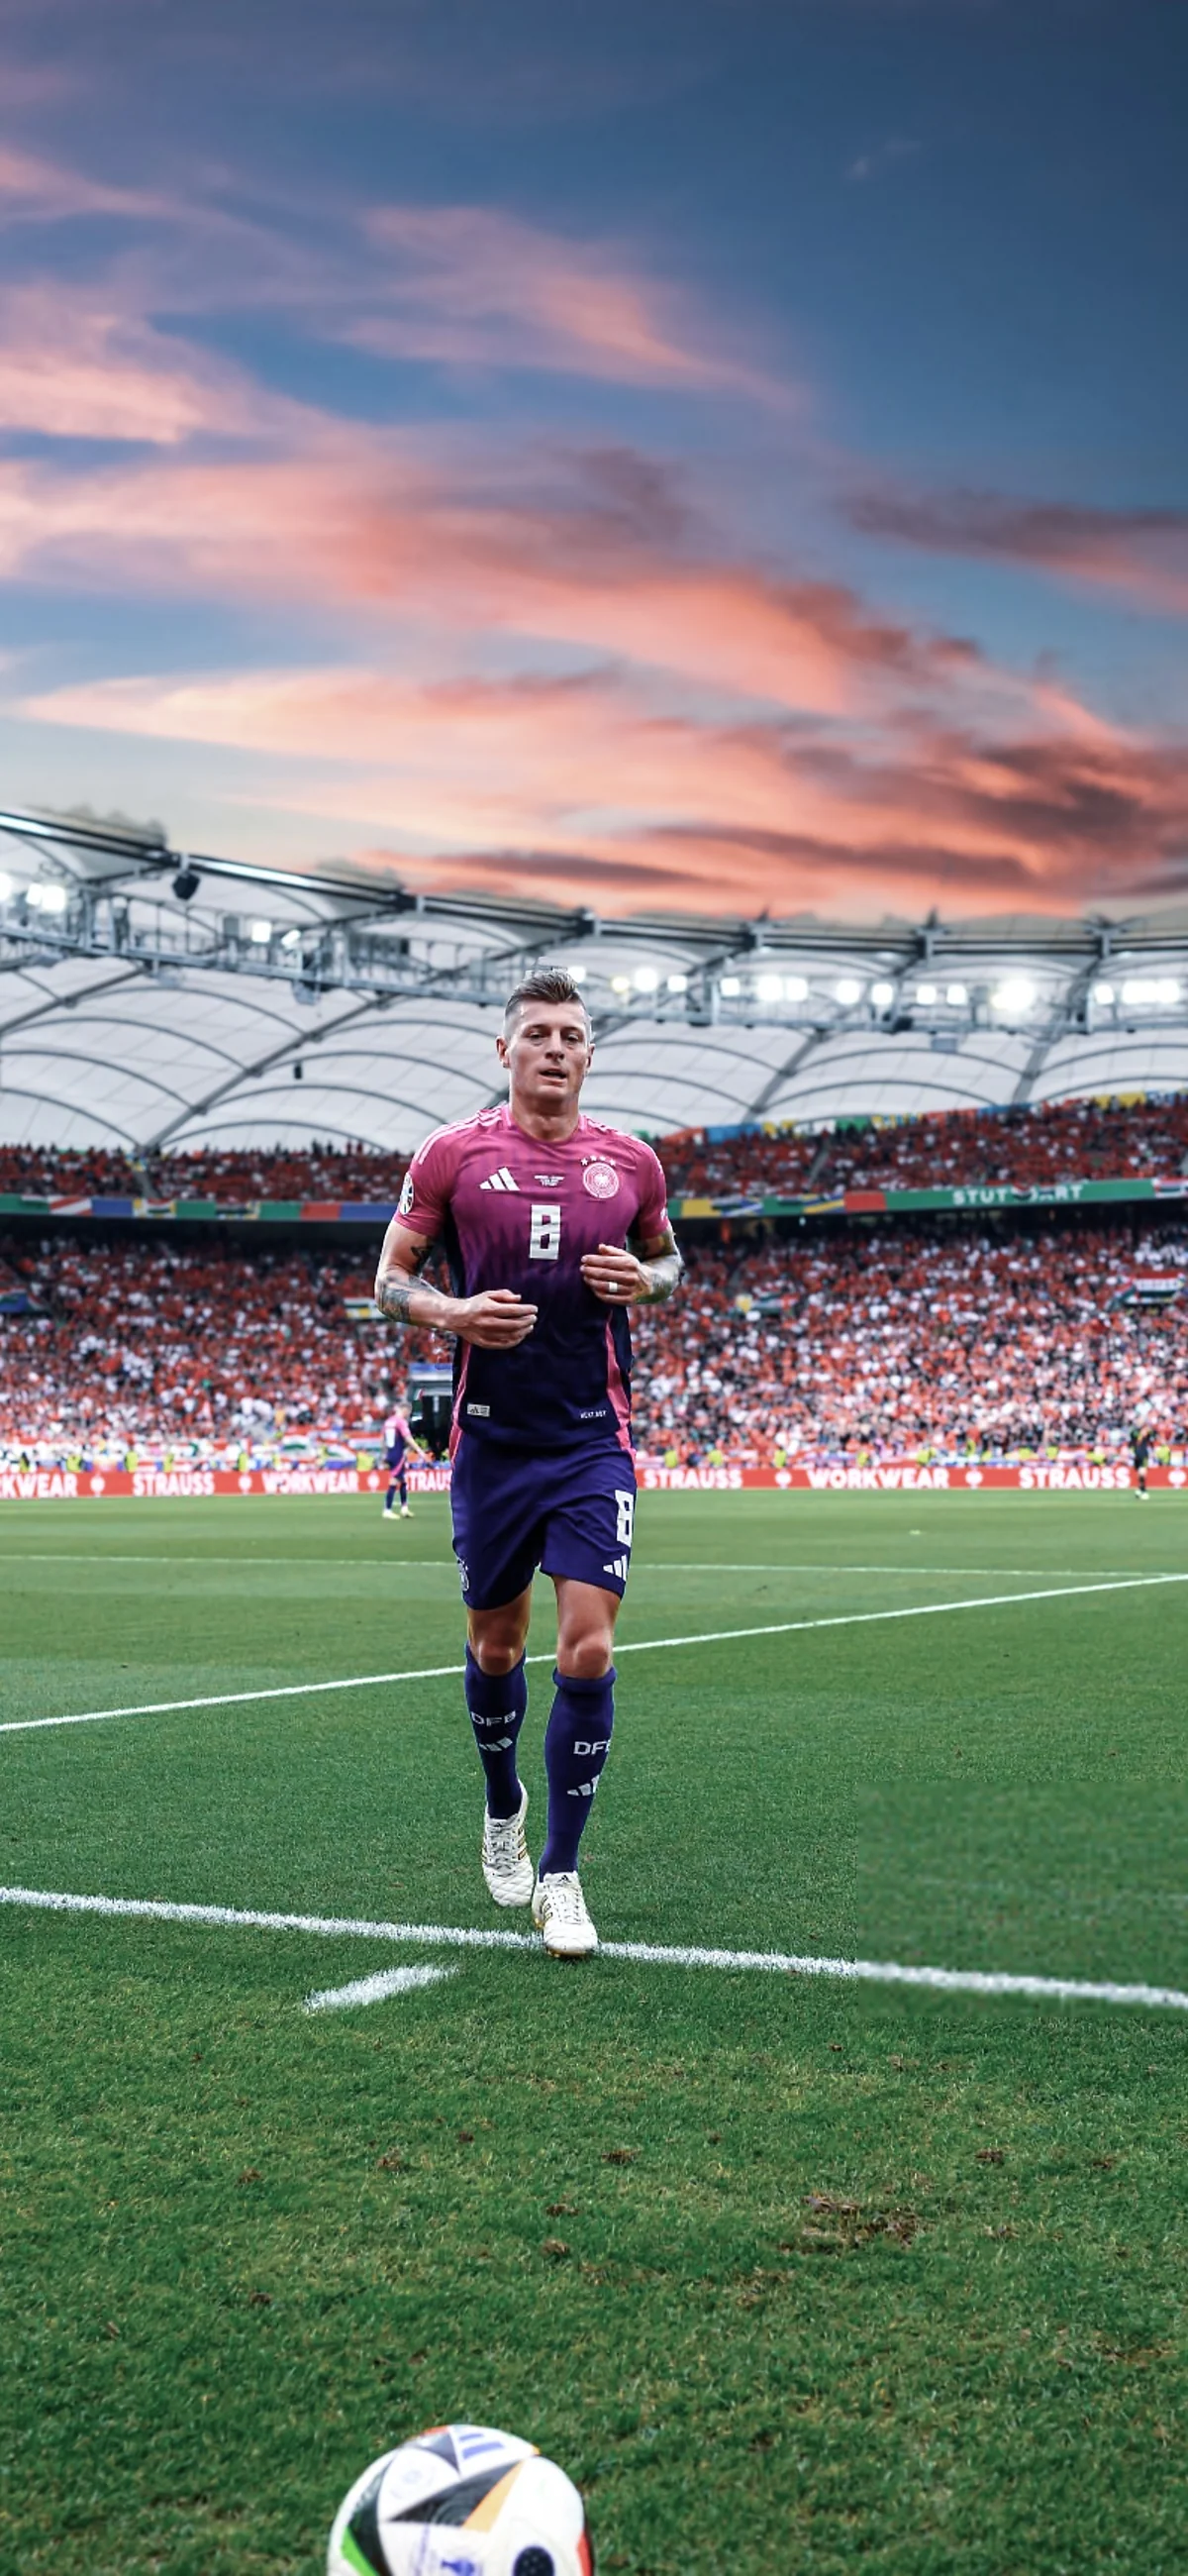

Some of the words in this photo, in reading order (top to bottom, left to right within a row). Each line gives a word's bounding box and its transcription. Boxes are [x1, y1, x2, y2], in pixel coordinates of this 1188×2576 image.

[530, 1204, 560, 1260] 8
[0, 1473, 77, 1497] KWEAR
[133, 1472, 215, 1495] STRAUSS
[261, 1471, 359, 1494] WORKWEAR
[644, 1469, 742, 1489] STRAUSS
[806, 1468, 949, 1489] WORKWEAR
[1019, 1467, 1131, 1489] STRAUSS
[615, 1490, 634, 1547] 8
[471, 1710, 517, 1726] DFB
